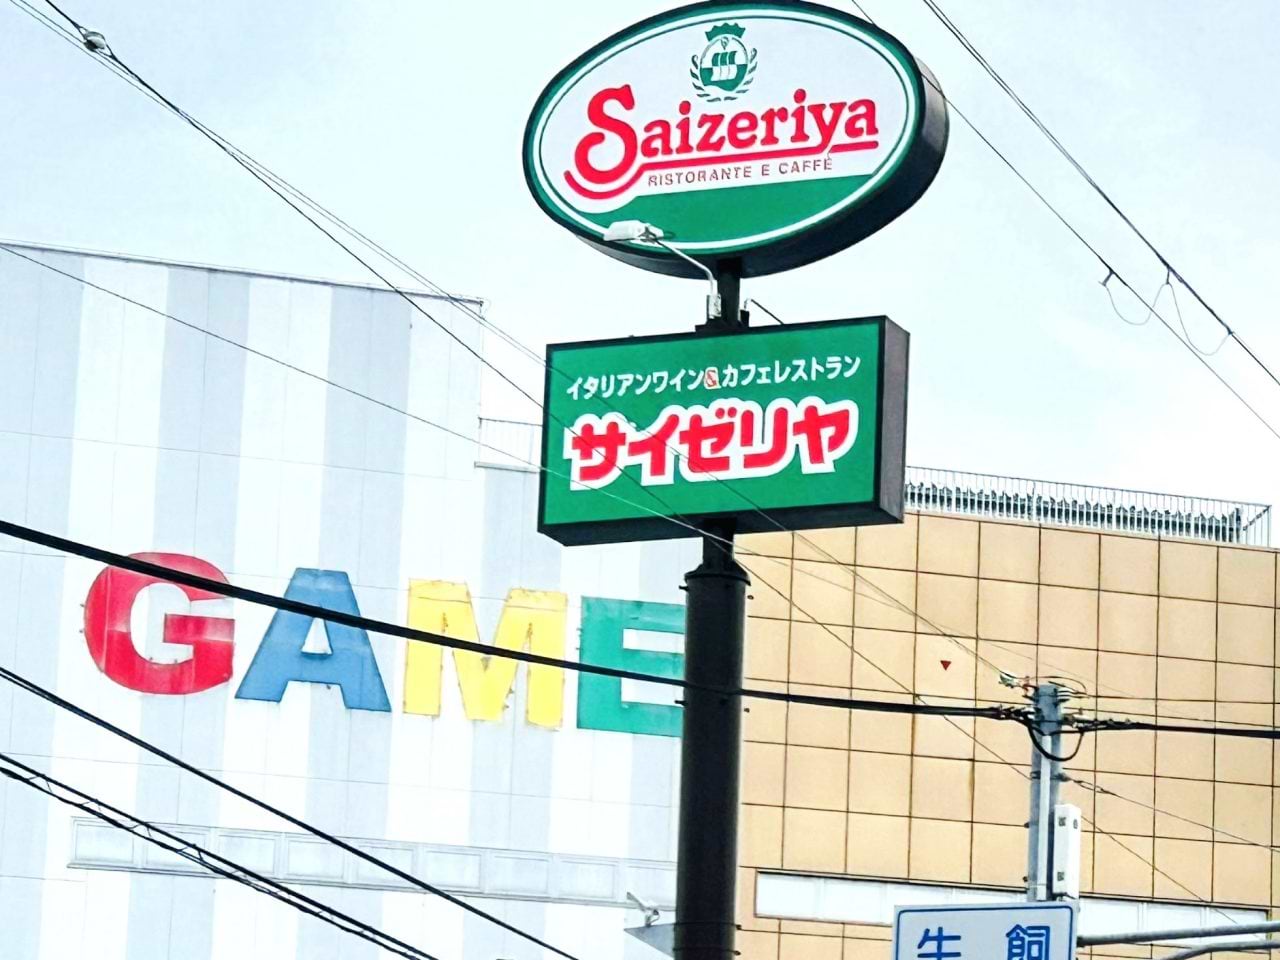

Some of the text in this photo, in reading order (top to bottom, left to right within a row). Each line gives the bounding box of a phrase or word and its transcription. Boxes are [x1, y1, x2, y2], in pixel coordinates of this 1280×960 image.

[564, 83, 879, 200] Saizeriya
[648, 165, 752, 188] RISTORANTE
[761, 164, 770, 177] E
[566, 399, 857, 487] サイゼリヤ
[83, 551, 685, 738] GAME
